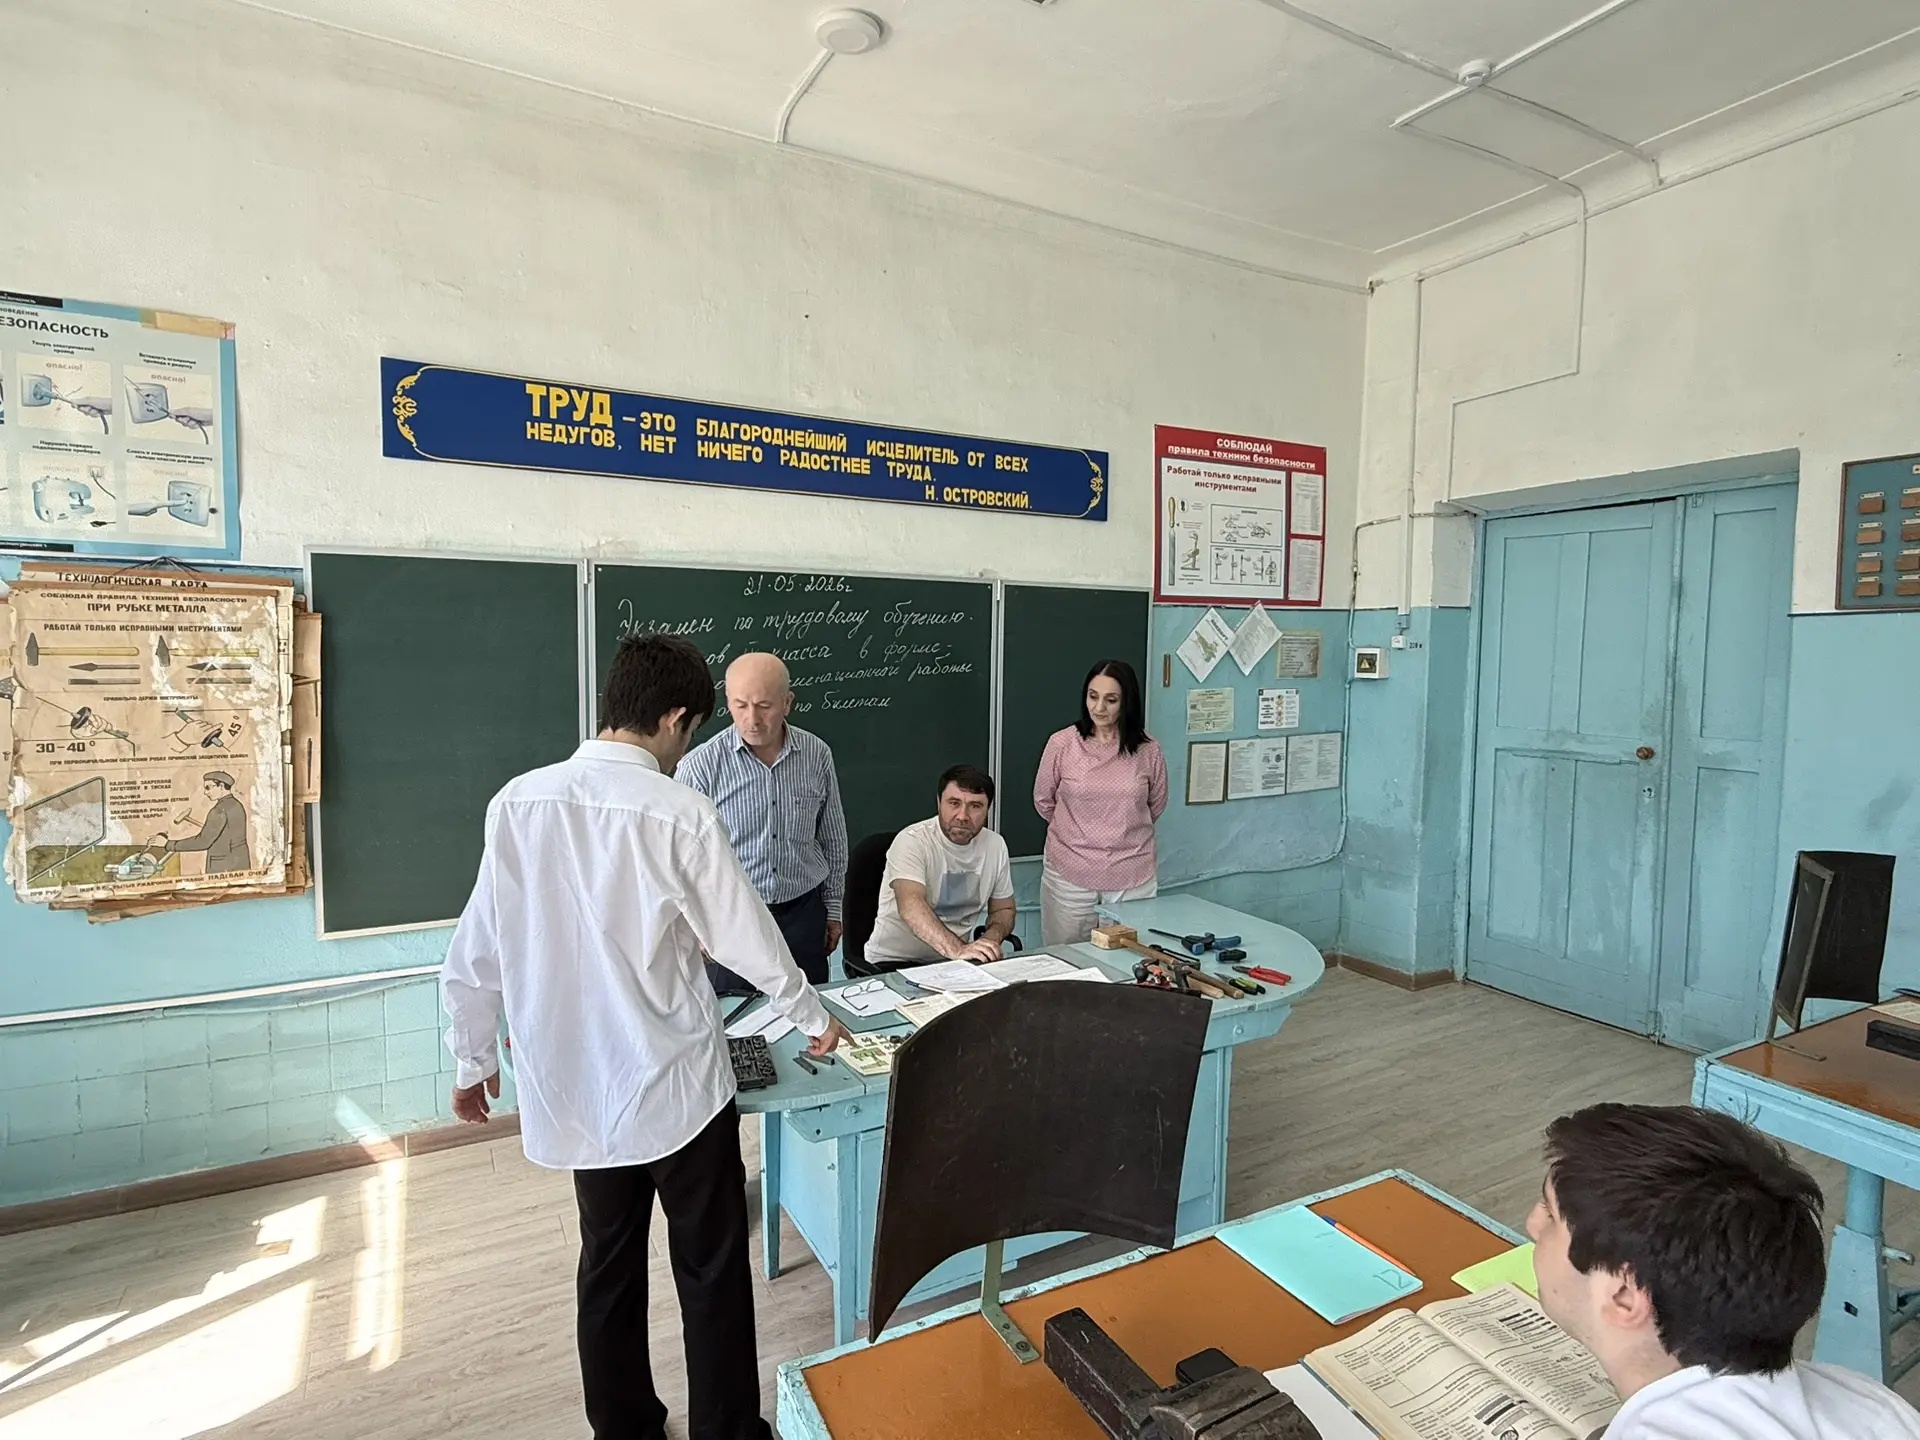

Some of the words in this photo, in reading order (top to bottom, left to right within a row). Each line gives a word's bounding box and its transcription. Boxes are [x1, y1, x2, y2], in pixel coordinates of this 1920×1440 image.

[0, 316, 109, 339] ЕЗОПАСНОСТЬ
[525, 383, 613, 428] ТРУД
[696, 417, 848, 453] БЛАГОРОДНЕЙШИЙ
[866, 439, 960, 465] ИСЦЕЛИТЕЛЬ
[967, 451, 985, 468] ОТ
[995, 455, 1029, 473] ВСЕХ
[526, 421, 622, 451] НЕДУГОВ,
[640, 433, 677, 455] НЕТ
[697, 440, 763, 464] НИЧЕГО
[780, 448, 871, 475] РАДОСТНЕЕ
[887, 460, 937, 482] ТРУДА.
[1216, 438, 1273, 454] СОБЛЮДАЙ
[1168, 445, 1210, 456] правила
[1213, 450, 1251, 462] техники
[1252, 453, 1316, 472] безопасности
[1166, 465, 1201, 476] Работай
[1203, 469, 1231, 480] только
[1233, 474, 1281, 485] исправными
[925, 485, 939, 502] Н.
[943, 487, 1033, 510] ОСТРОВСКИЙ.
[1194, 481, 1257, 493] инструментами
[57, 572, 162, 588] ТЕХНОЛОГИЧЕСКАЯ
[171, 580, 209, 590] КАРТА
[40, 592, 93, 600] СОБЛЮДАЙ
[87, 603, 111, 612] ПРИ
[116, 603, 155, 613] РУБКЕ
[155, 604, 207, 614] МЕТАЛЛА
[43, 623, 81, 632] РАБОТАЙ
[85, 624, 116, 632] ТОЛЬКО
[119, 624, 175, 633] ИСПРАВНЫМИ
[178, 625, 243, 633] ИНСТРУМЕНТАМИ
[732, 615, 754, 631] по
[763, 600, 869, 641] трудовому
[859, 634, 873, 660] в
[906, 652, 973, 682] работы
[795, 699, 812, 712] по
[822, 689, 892, 710] билетам
[208, 871, 245, 881] НАДЕВАЙ
